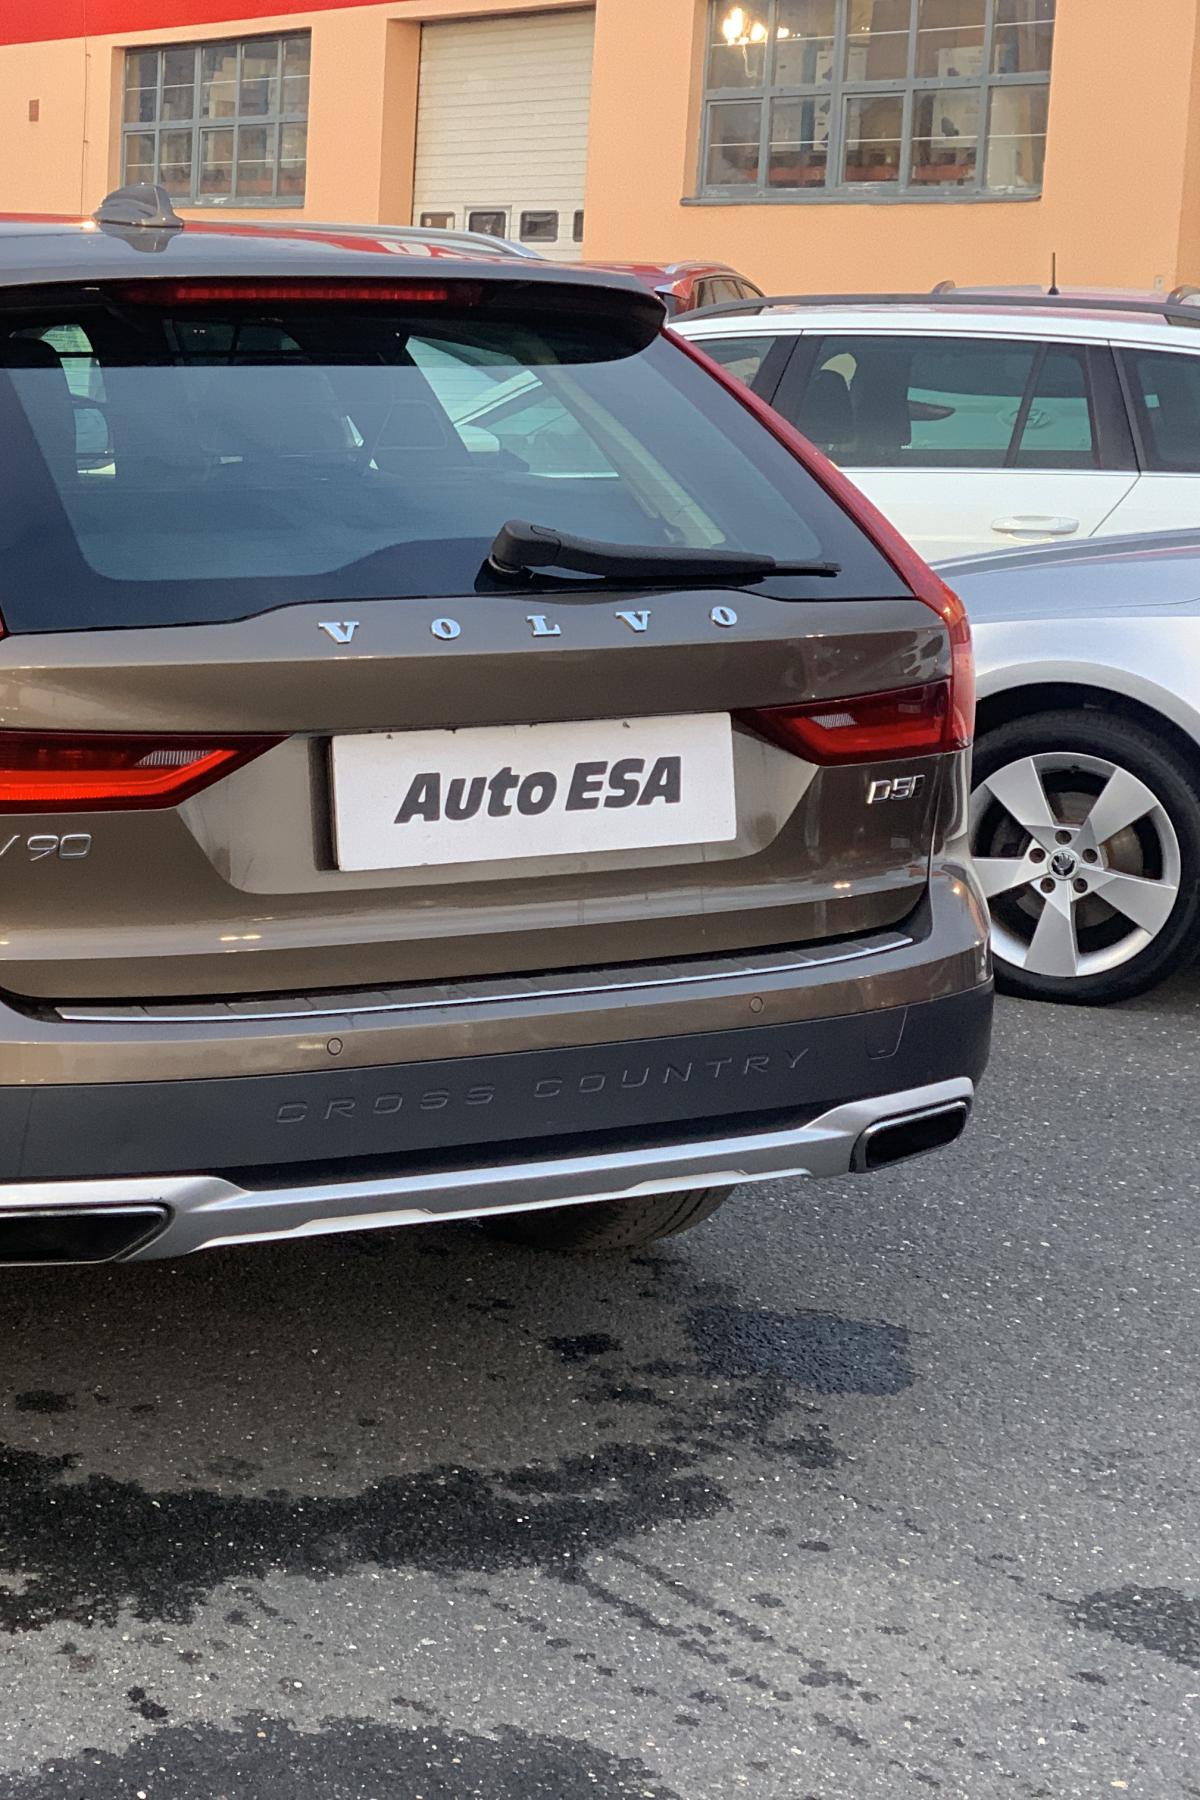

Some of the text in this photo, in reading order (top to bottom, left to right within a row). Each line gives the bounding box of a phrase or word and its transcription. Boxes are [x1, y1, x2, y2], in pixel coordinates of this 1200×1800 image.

[318, 605, 738, 644] VOLVO
[276, 1047, 810, 1124] CROSS COUNTRY
